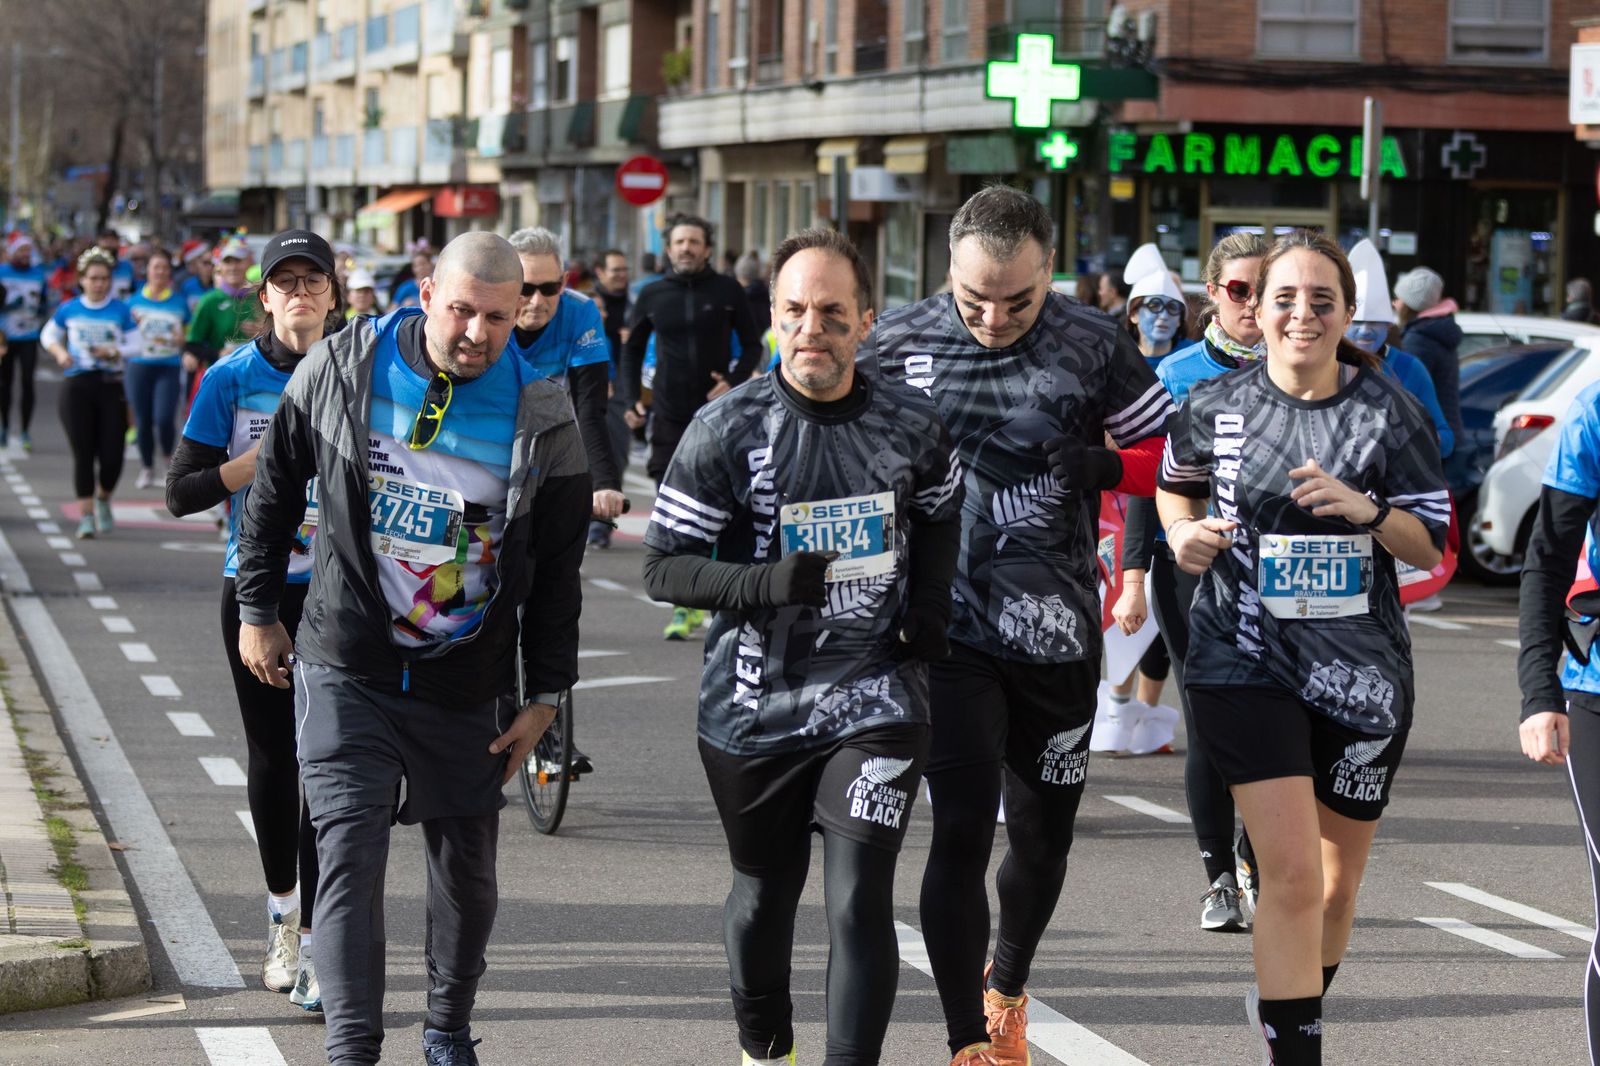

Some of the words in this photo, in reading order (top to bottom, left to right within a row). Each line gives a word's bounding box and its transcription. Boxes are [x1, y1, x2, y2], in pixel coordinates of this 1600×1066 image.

[1108, 132, 1407, 178] FARMACIA
[280, 238, 309, 247] KIPRUN
[385, 480, 455, 507] SETEL
[747, 445, 778, 558] ALAND
[370, 493, 436, 538] 4745
[811, 499, 884, 519] SETEL
[796, 519, 871, 554] 3034
[1290, 541, 1362, 554] SETEL
[1274, 558, 1347, 591] 3450
[732, 620, 764, 711] NEW
[1044, 752, 1060, 760] NEW
[1060, 759, 1082, 769] HEART
[1040, 764, 1087, 785] BLACK
[1337, 769, 1351, 778] MY
[1354, 773, 1379, 783] HEART
[1340, 762, 1357, 772] NEW
[1360, 766, 1388, 774] ZEALAND
[854, 788, 869, 799] MY
[871, 792, 898, 807] HEART
[855, 780, 875, 791] NEW
[878, 785, 908, 801] ZEALAND
[1332, 776, 1384, 801] BLACK
[850, 797, 903, 829] BLACK
